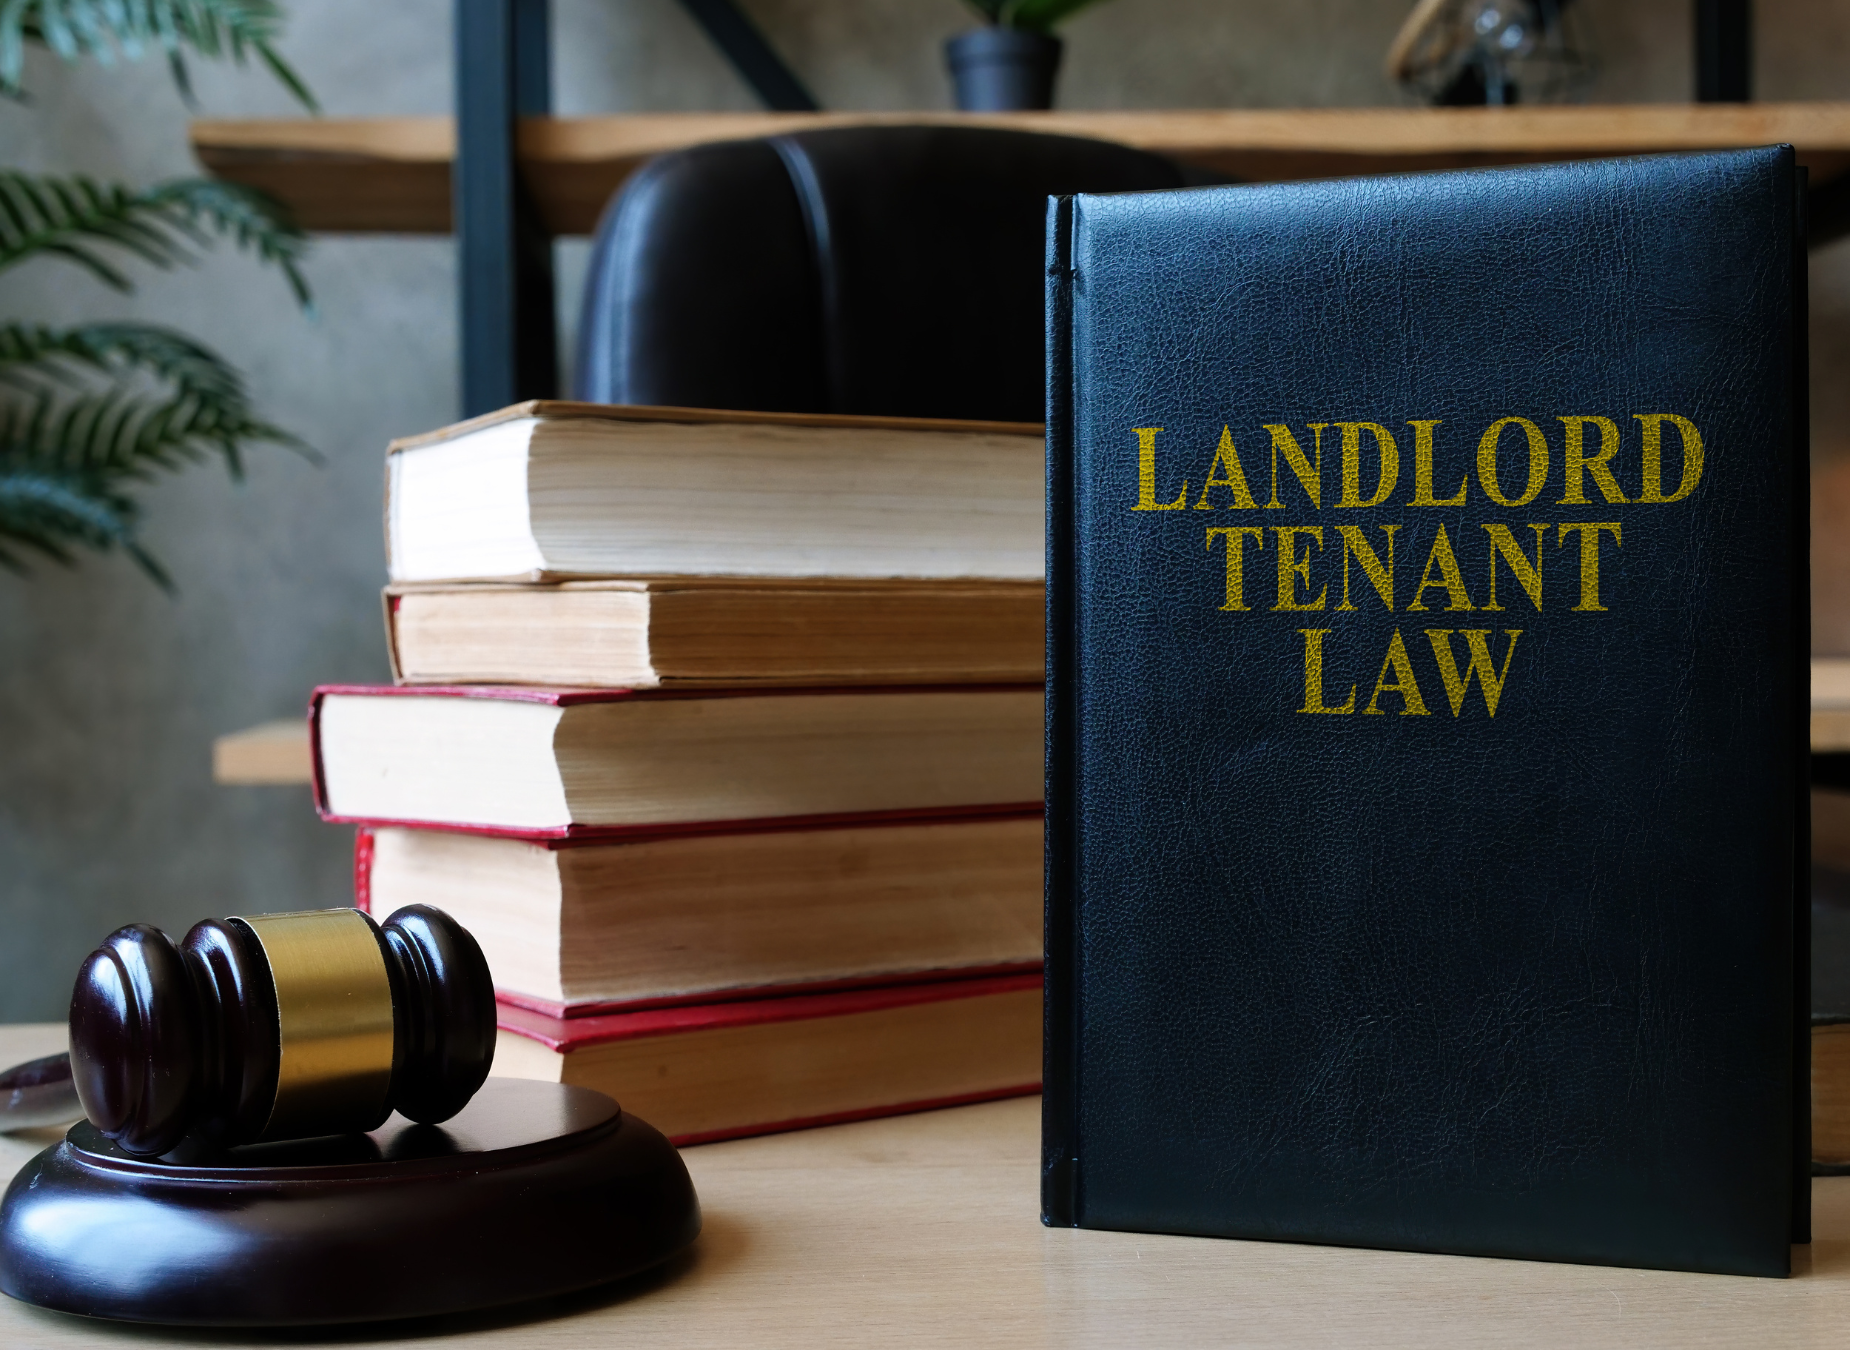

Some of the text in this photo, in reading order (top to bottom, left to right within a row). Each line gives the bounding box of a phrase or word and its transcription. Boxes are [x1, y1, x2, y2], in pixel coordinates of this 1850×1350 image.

[1130, 413, 1705, 511] LANDLORD
[1205, 522, 1622, 612] TENANT
[1296, 627, 1524, 718] LAW
